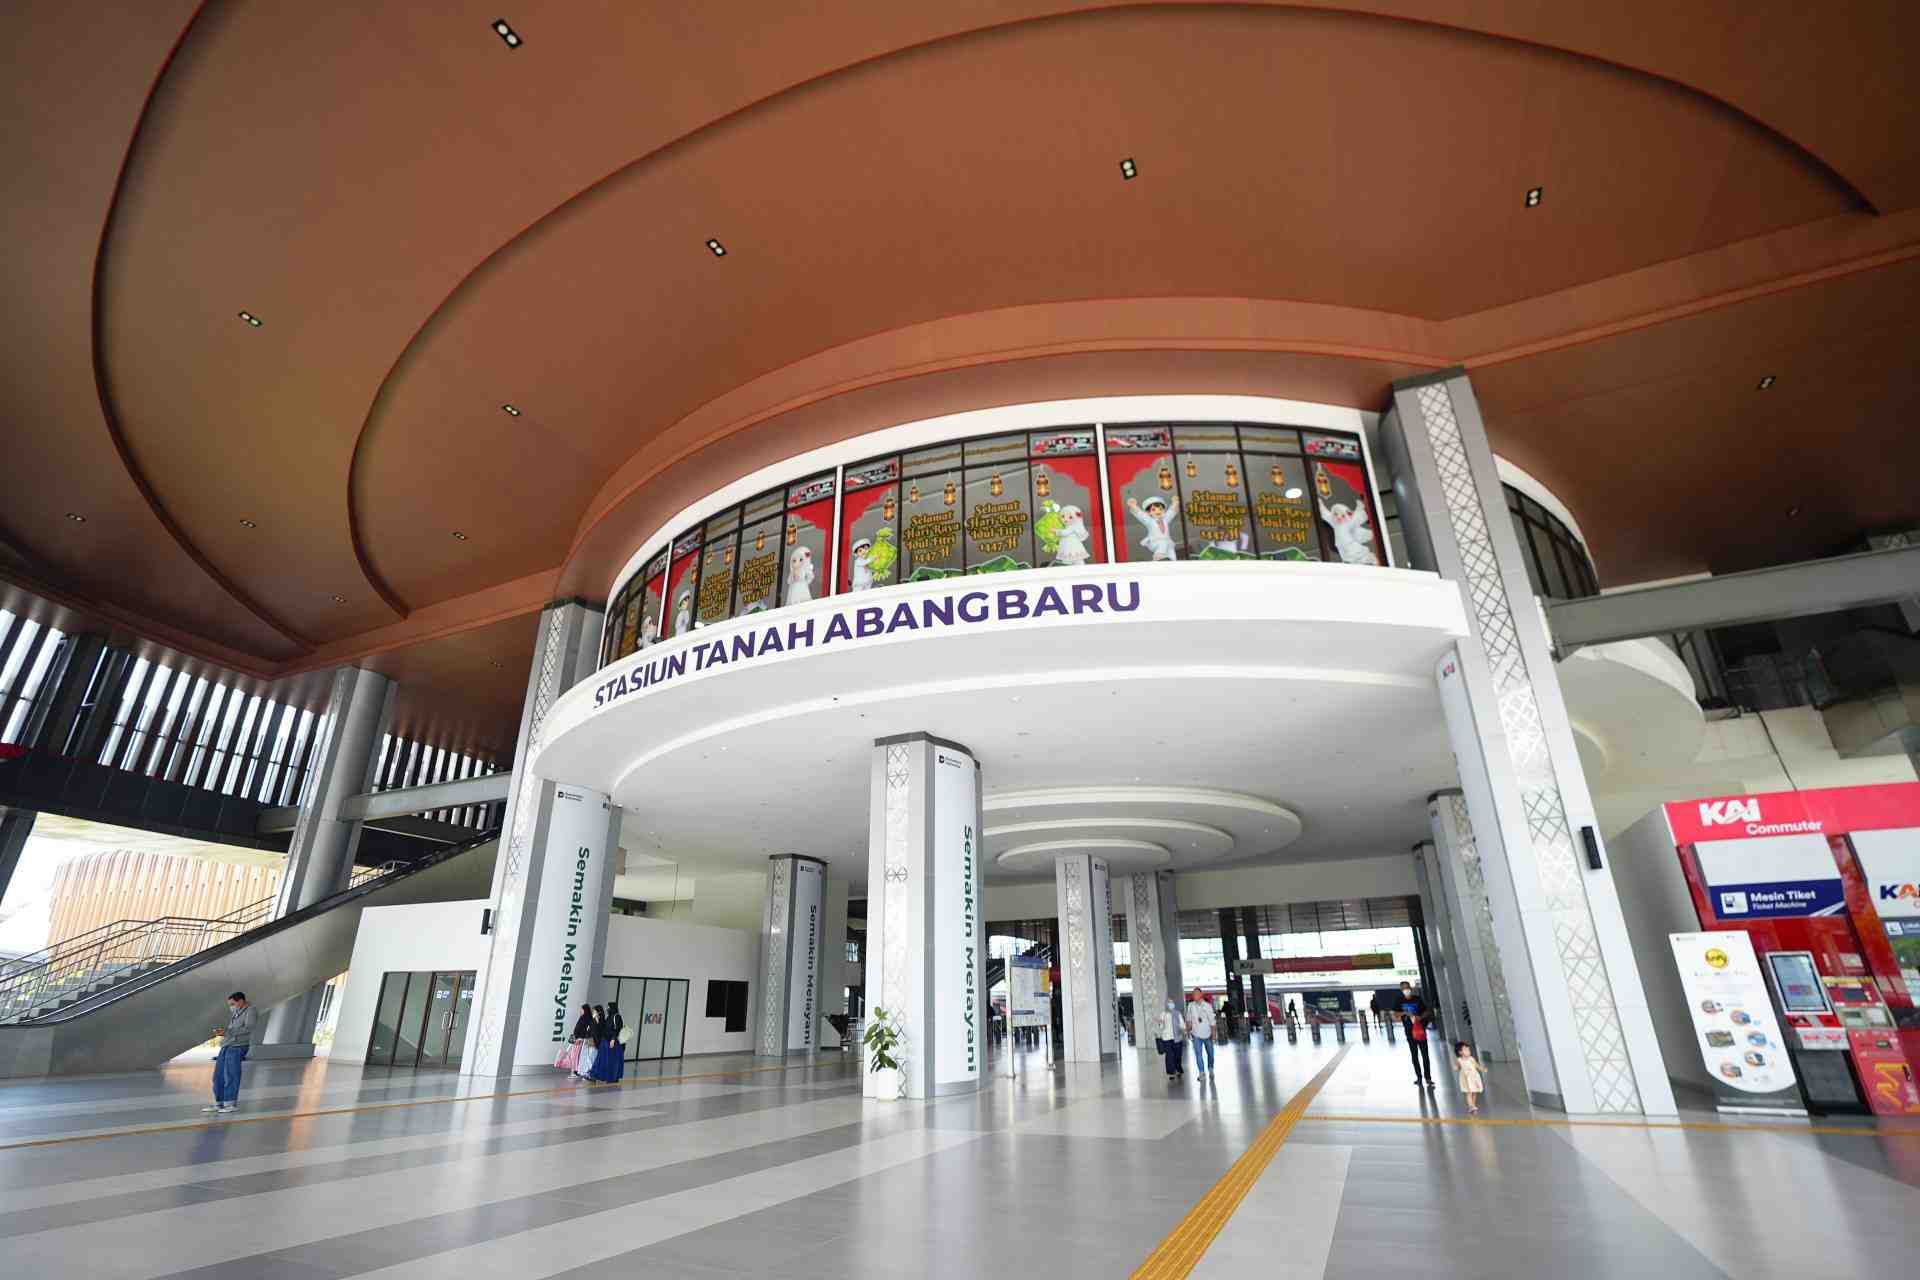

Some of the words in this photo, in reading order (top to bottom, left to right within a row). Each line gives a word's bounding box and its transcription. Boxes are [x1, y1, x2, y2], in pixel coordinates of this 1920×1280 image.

[911, 510, 955, 526] Selamat
[966, 515, 996, 529] Hari
[998, 512, 1028, 526] Raya
[974, 500, 1021, 515] Selamat
[904, 525, 931, 540] Hari
[932, 521, 961, 536] Raya
[593, 648, 688, 709] STASIUN
[692, 619, 815, 671] TANAH
[822, 592, 989, 644] ABANG
[997, 582, 1140, 620] BARU
[1698, 798, 1761, 826] KAI
[1745, 821, 1823, 835] Commuter
[567, 847, 590, 937] Semakin
[963, 823, 974, 938] Semakin
[1880, 883, 1920, 900] KA
[1750, 891, 1785, 902] Mesin
[1786, 890, 1816, 900] Tiket
[807, 905, 817, 970] Semakin
[552, 943, 577, 1043] Melayani
[804, 974, 814, 1046] Melayani
[963, 947, 977, 1072] Melayani
